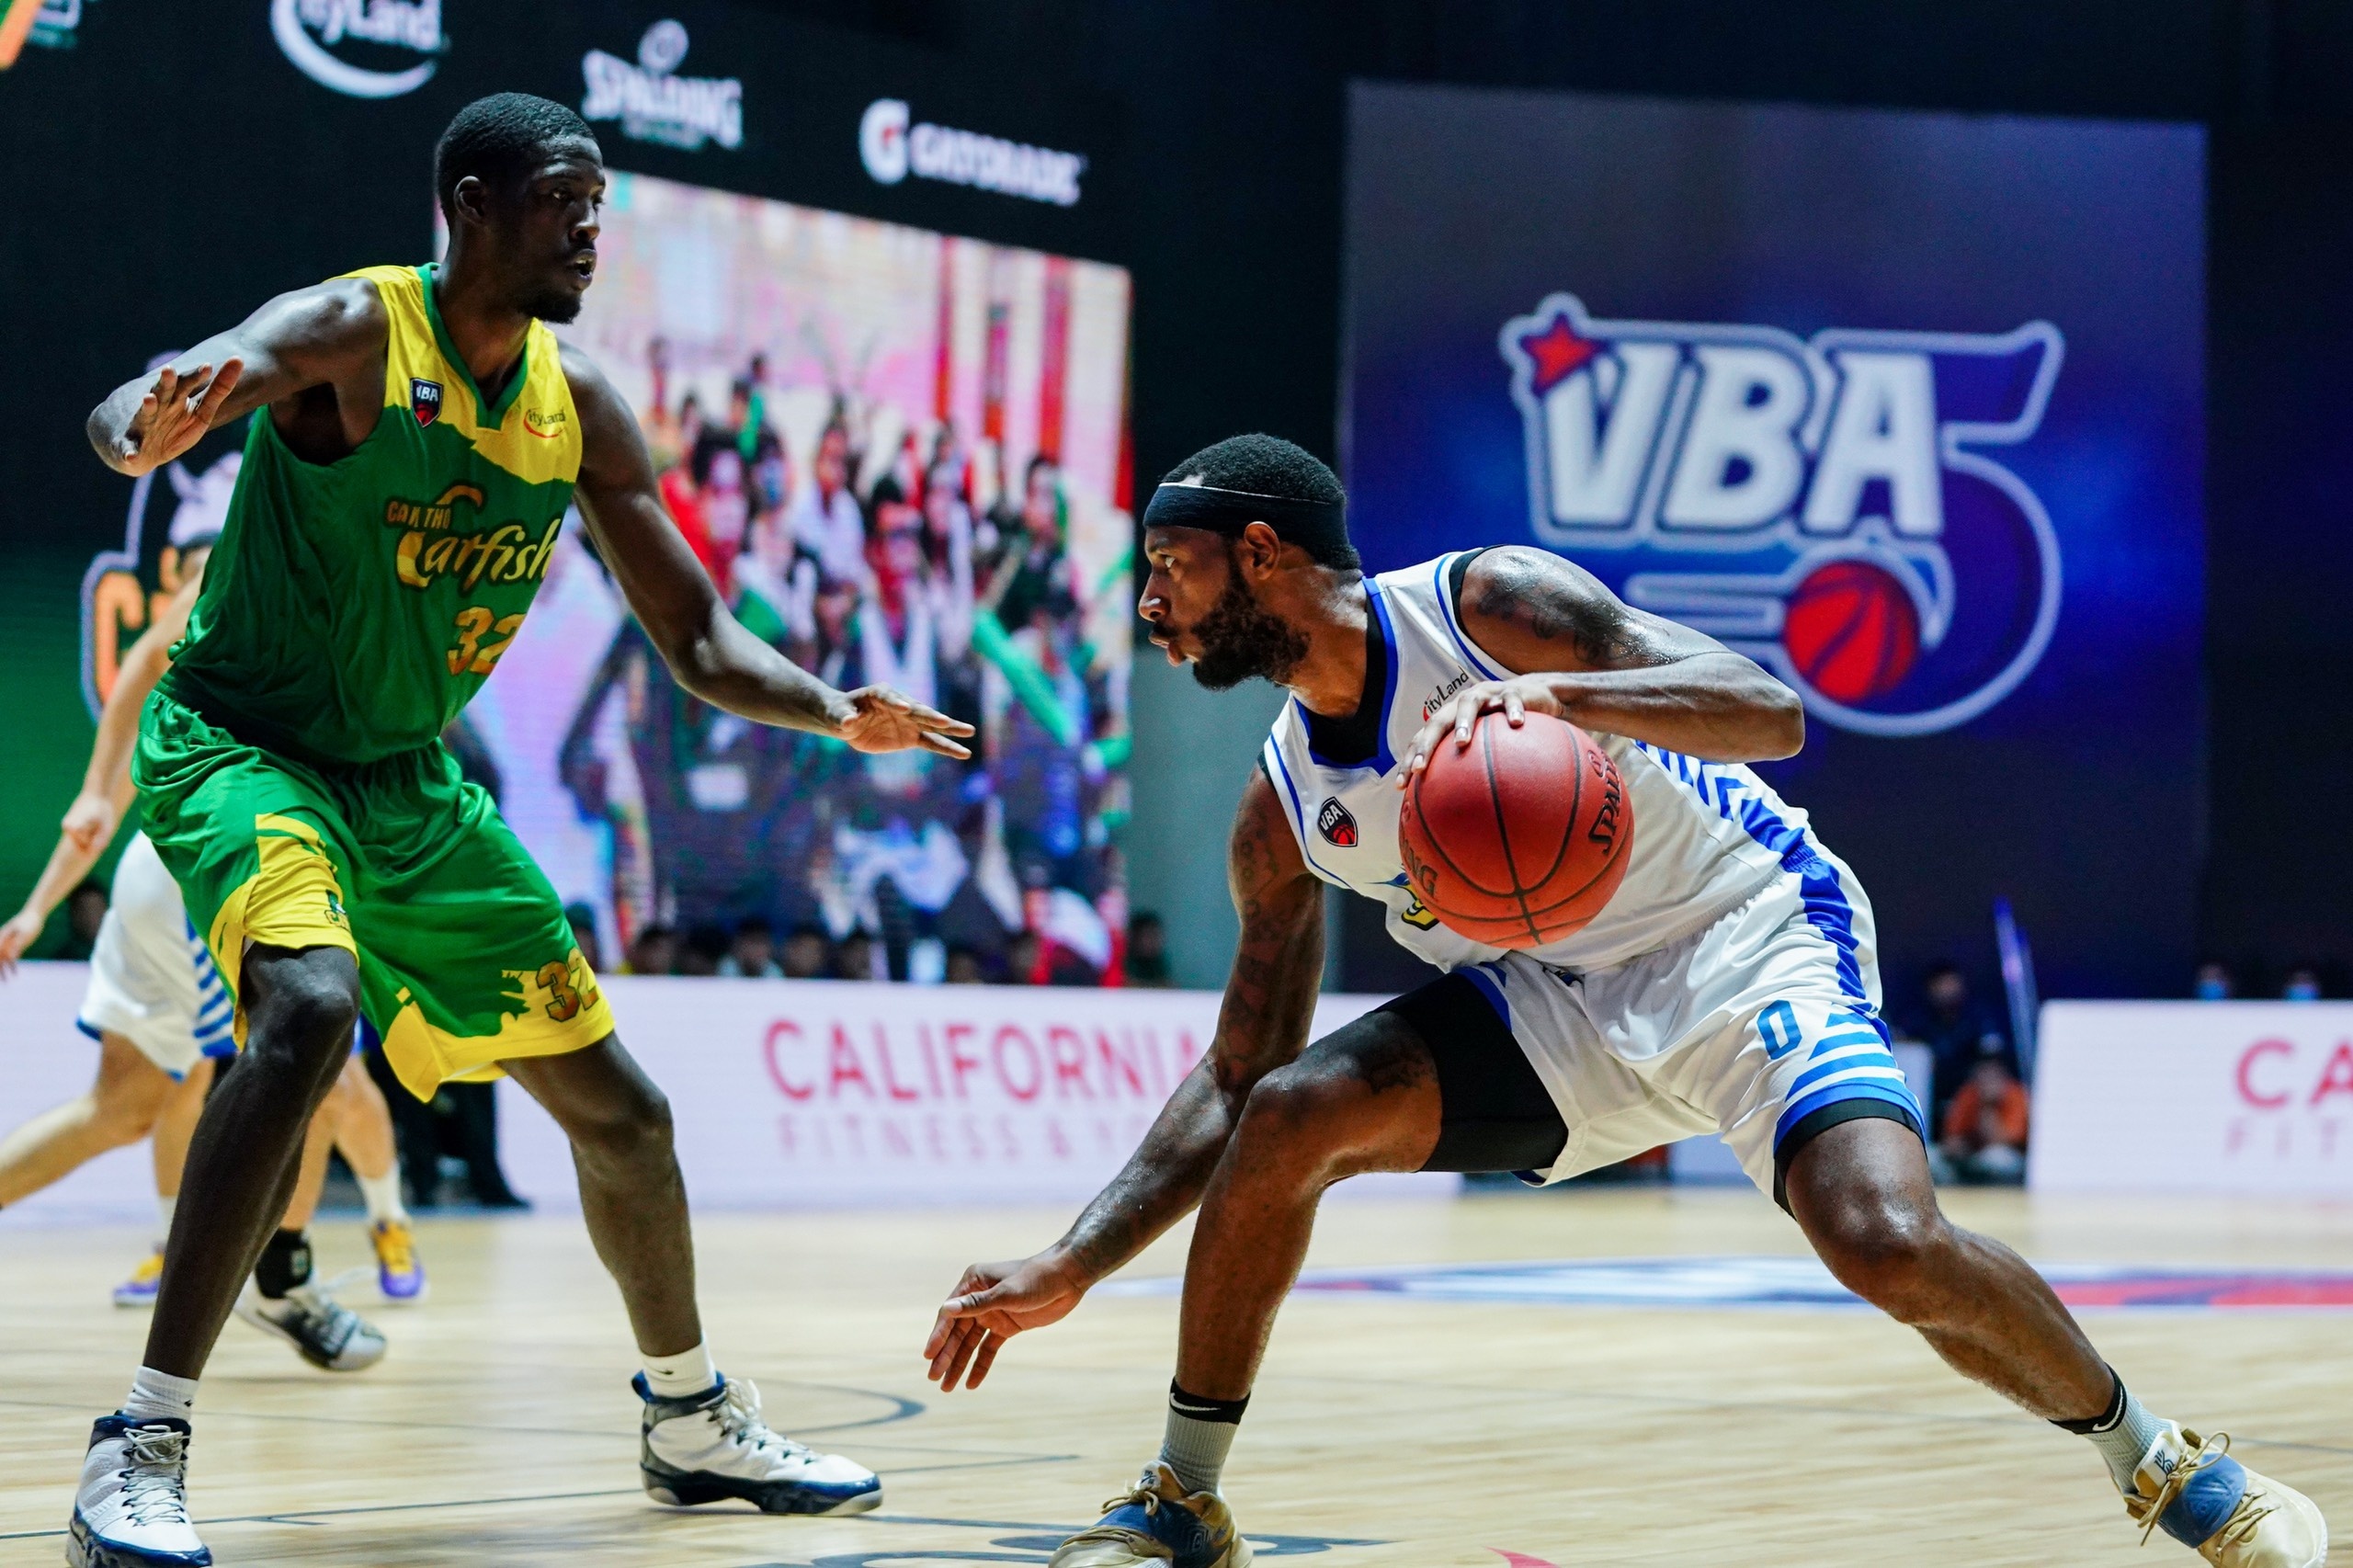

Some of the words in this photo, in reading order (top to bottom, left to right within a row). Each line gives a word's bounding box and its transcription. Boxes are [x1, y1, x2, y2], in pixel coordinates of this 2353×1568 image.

[1541, 338, 1945, 537] VBA
[448, 606, 527, 676] 32
[1320, 804, 1344, 832] VBA
